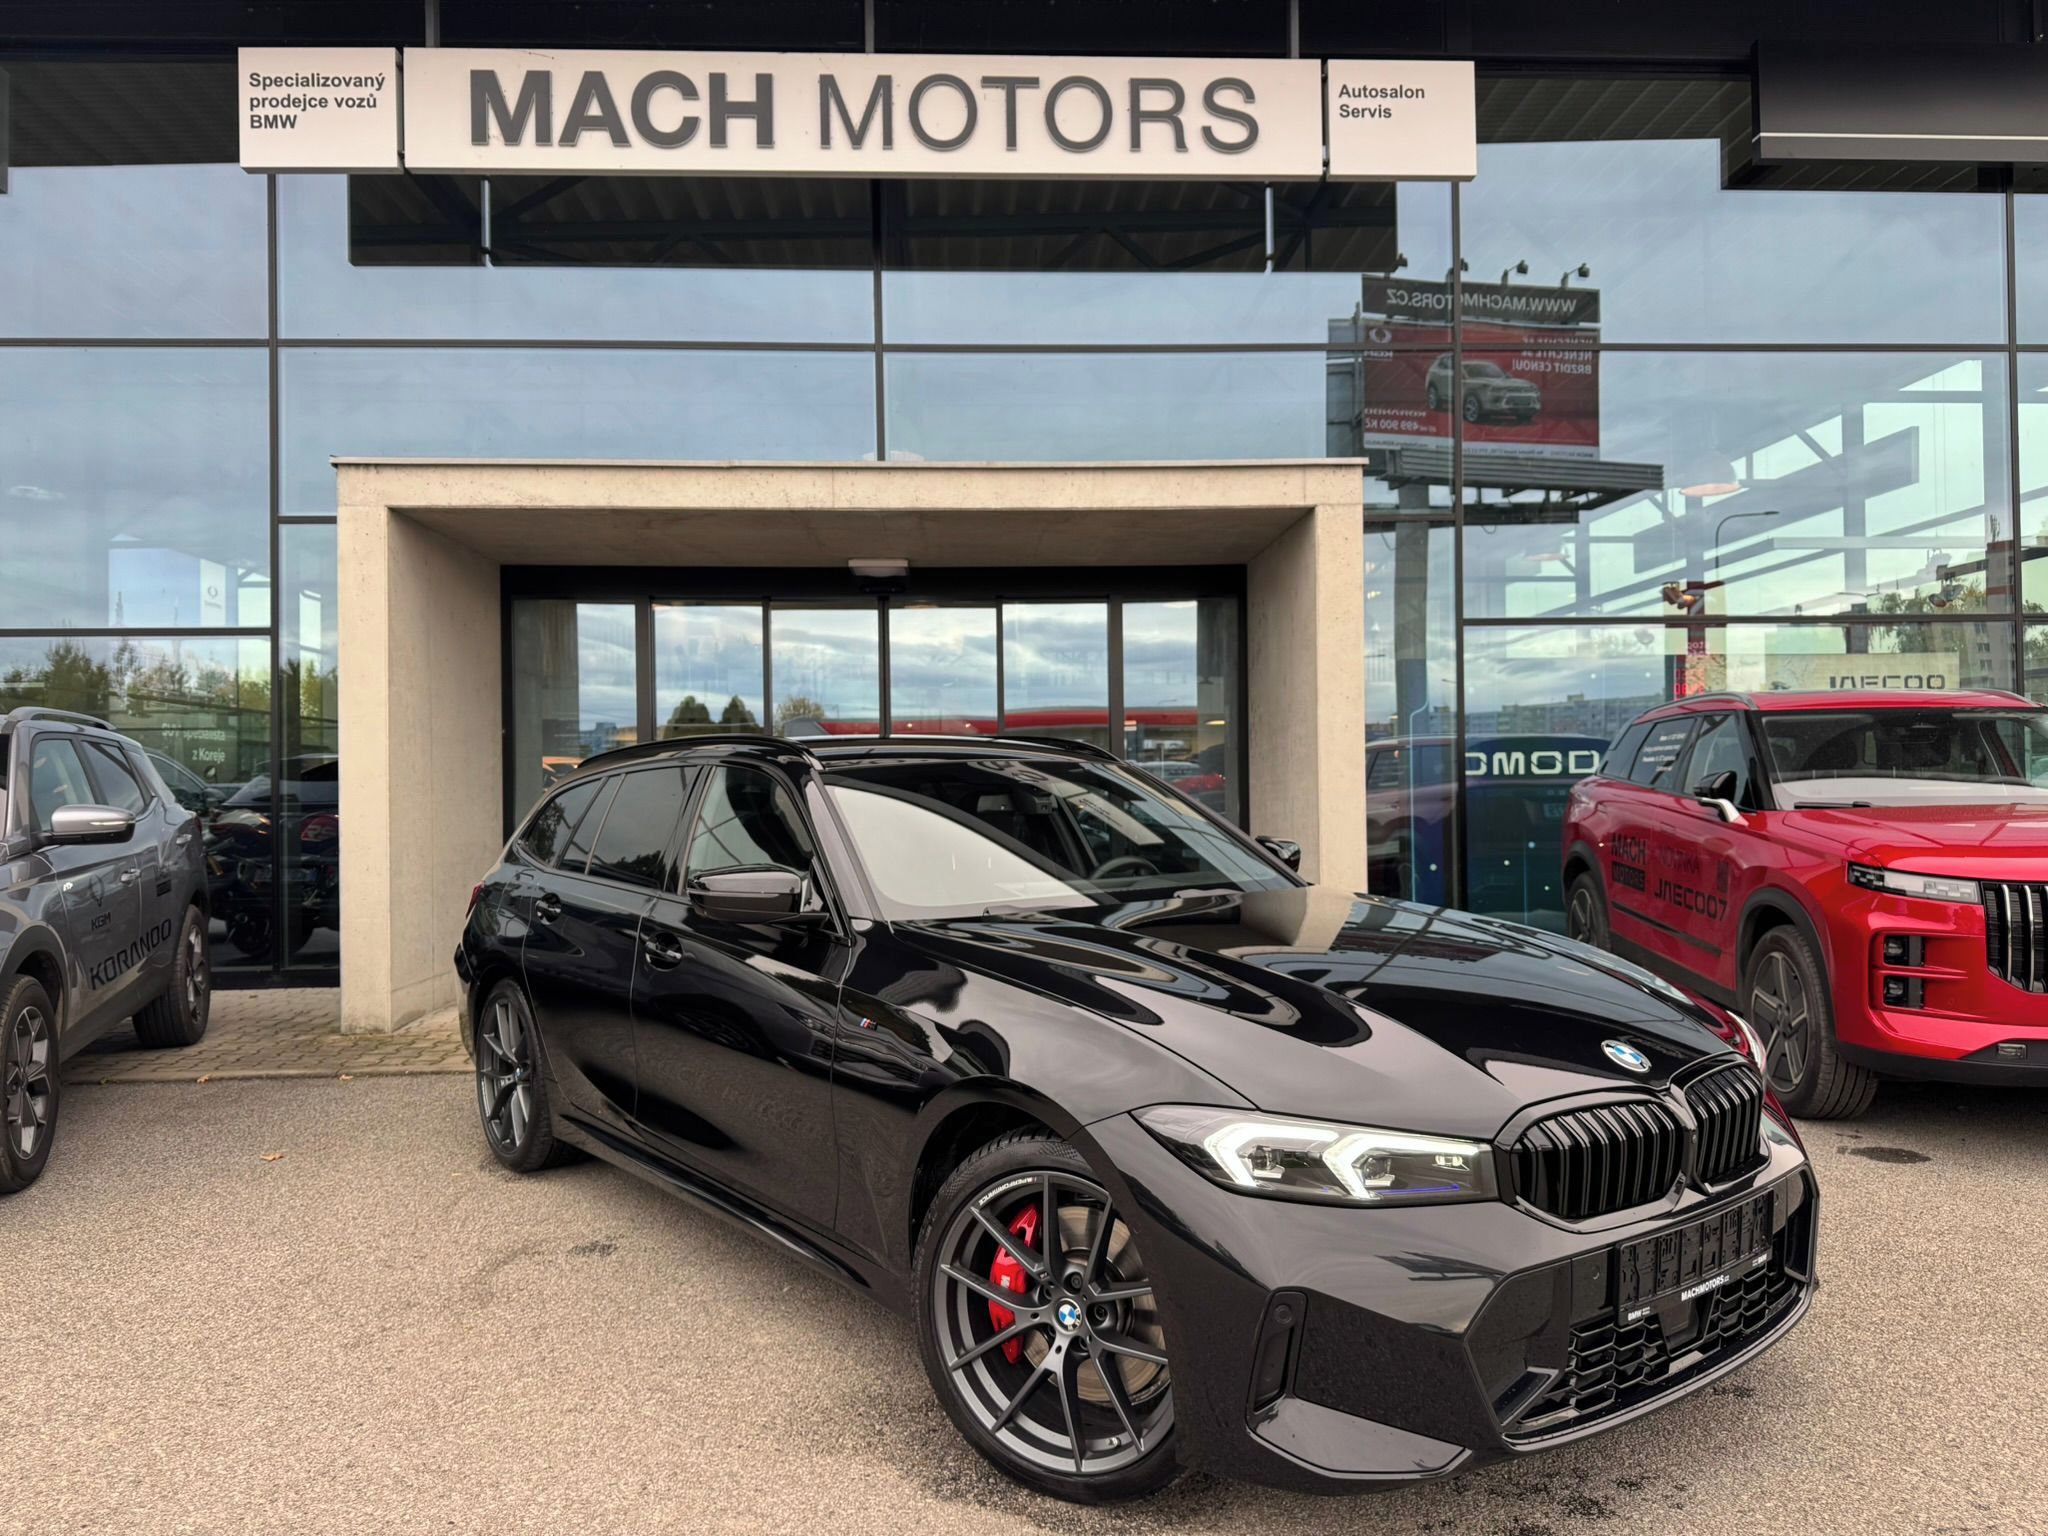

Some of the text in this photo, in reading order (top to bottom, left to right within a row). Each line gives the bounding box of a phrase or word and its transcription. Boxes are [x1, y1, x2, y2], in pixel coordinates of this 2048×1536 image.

[249, 72, 386, 91] Specializovaný
[1338, 84, 1425, 99] Autosalon
[250, 93, 378, 111] prodejce vozů
[470, 69, 1260, 154] MACH MOTORS
[1339, 103, 1392, 119] Servis
[250, 114, 298, 129] BMW
[1611, 832, 1647, 865] MACH
[91, 911, 112, 931] KGM
[89, 918, 172, 991] KORANDO
